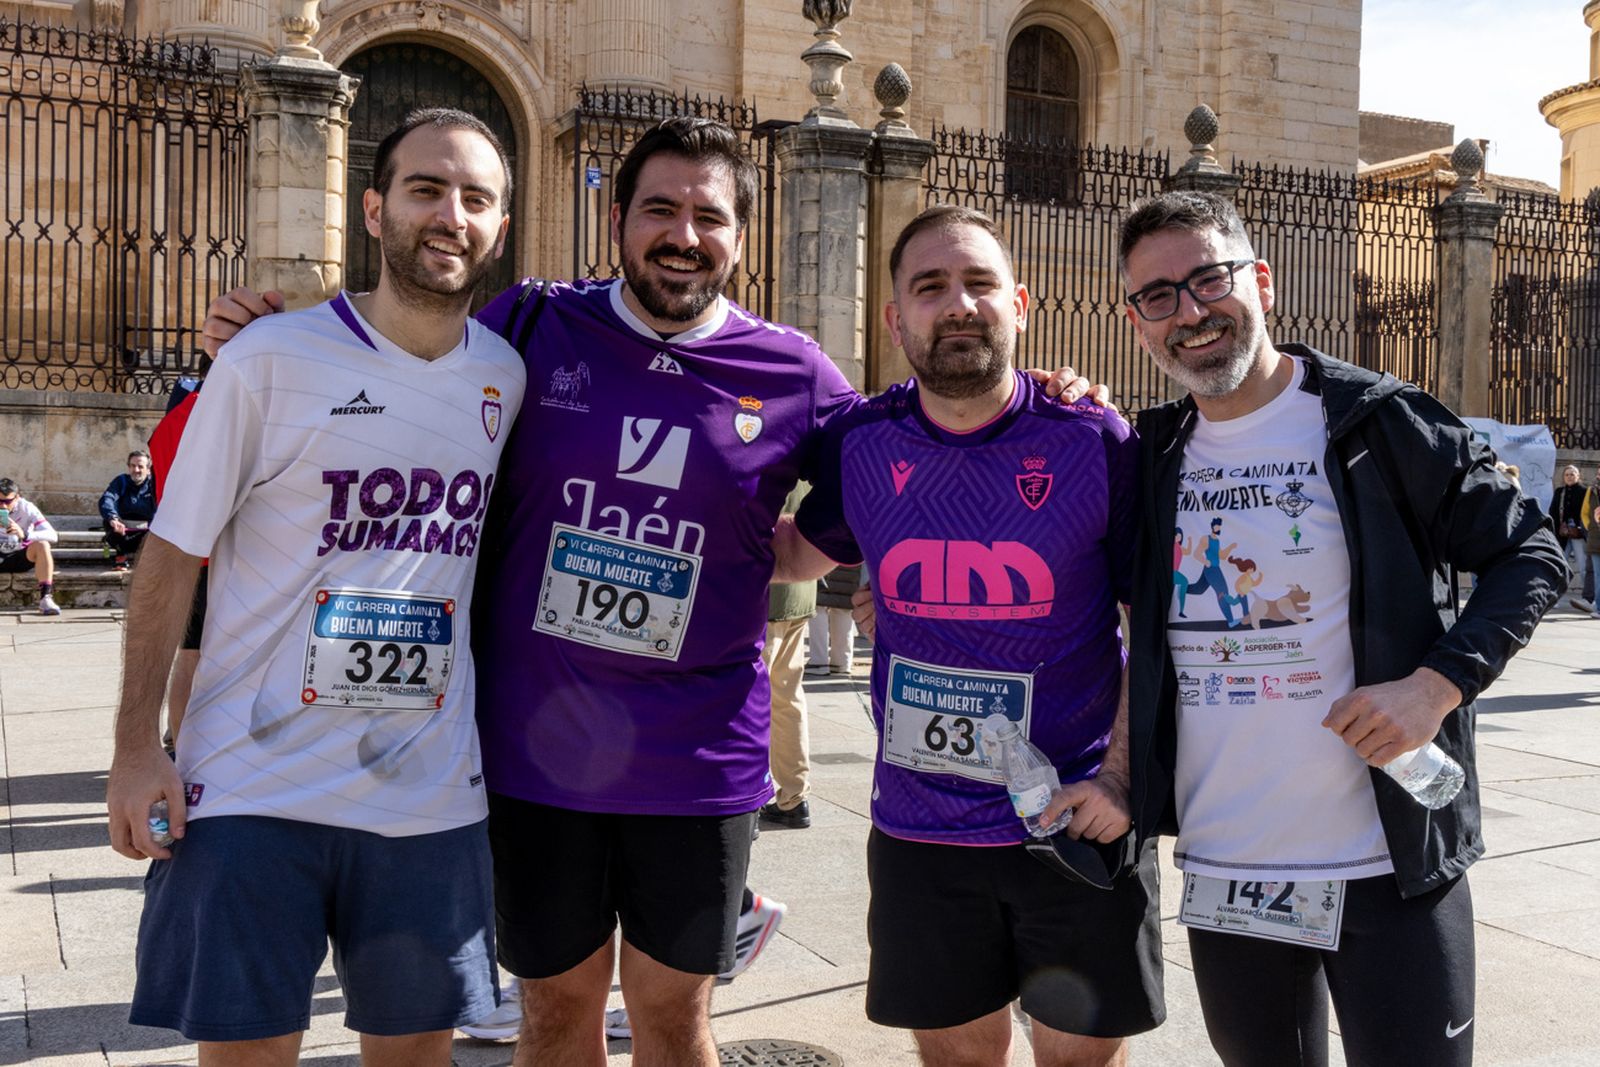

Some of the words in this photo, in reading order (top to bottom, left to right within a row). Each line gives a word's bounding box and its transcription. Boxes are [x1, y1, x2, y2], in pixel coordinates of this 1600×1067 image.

[655, 357, 678, 372] 2A
[330, 405, 386, 416] MERCURY
[1179, 467, 1224, 483] ARRERA
[1229, 461, 1318, 478] CAMINATA
[1202, 484, 1273, 511] MUERTE
[562, 477, 706, 559] Jaén
[317, 519, 480, 557] SUMAMOS
[570, 539, 580, 549] VI
[580, 541, 625, 560] CARRERA
[627, 552, 678, 572] CAMINATA
[564, 553, 601, 576] BUENA
[604, 562, 653, 587] MUERTE
[335, 601, 345, 611] VI
[347, 601, 396, 614] CARRERA
[399, 604, 441, 618] CAMINATA
[575, 579, 650, 629] 190
[330, 616, 374, 635] BUENA
[377, 620, 424, 638] MUERTE
[572, 617, 590, 626] PABLO
[1244, 641, 1302, 652] ASPERGER-TEA
[345, 641, 428, 685] 322
[904, 670, 912, 680] VI
[912, 672, 953, 689] CARRERA
[956, 680, 1009, 694] CAMINATA
[1287, 675, 1322, 684] VICTORIA
[902, 685, 934, 706] BUENA
[937, 692, 984, 713] MUERTE
[924, 714, 976, 756] 63
[1217, 904, 1239, 913] ÁLVARO
[1227, 880, 1295, 913] 142
